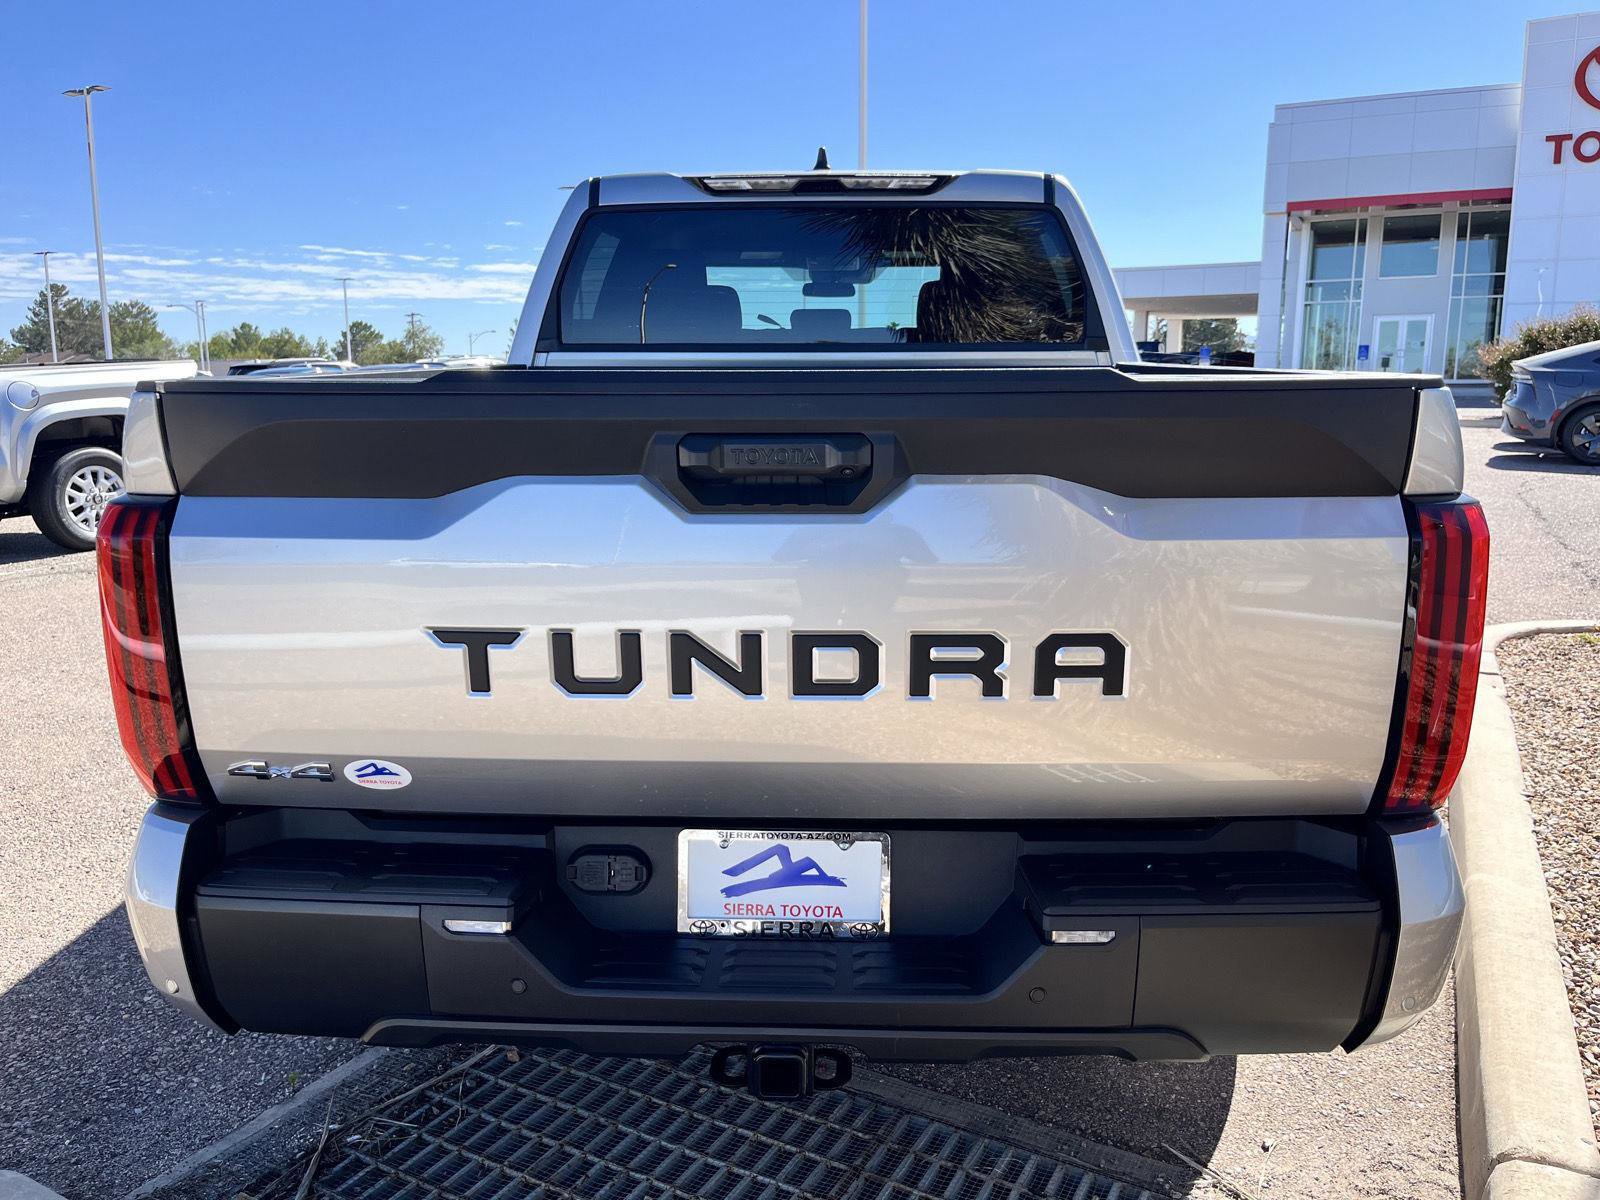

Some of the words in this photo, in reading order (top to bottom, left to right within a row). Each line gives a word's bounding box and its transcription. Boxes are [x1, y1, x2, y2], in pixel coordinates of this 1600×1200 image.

[730, 447, 820, 465] TOYOTA
[425, 627, 1130, 699] TUNDRA
[723, 903, 775, 916] SIERRA
[780, 904, 843, 918] TOYOTA
[733, 921, 835, 939] SIERRA
